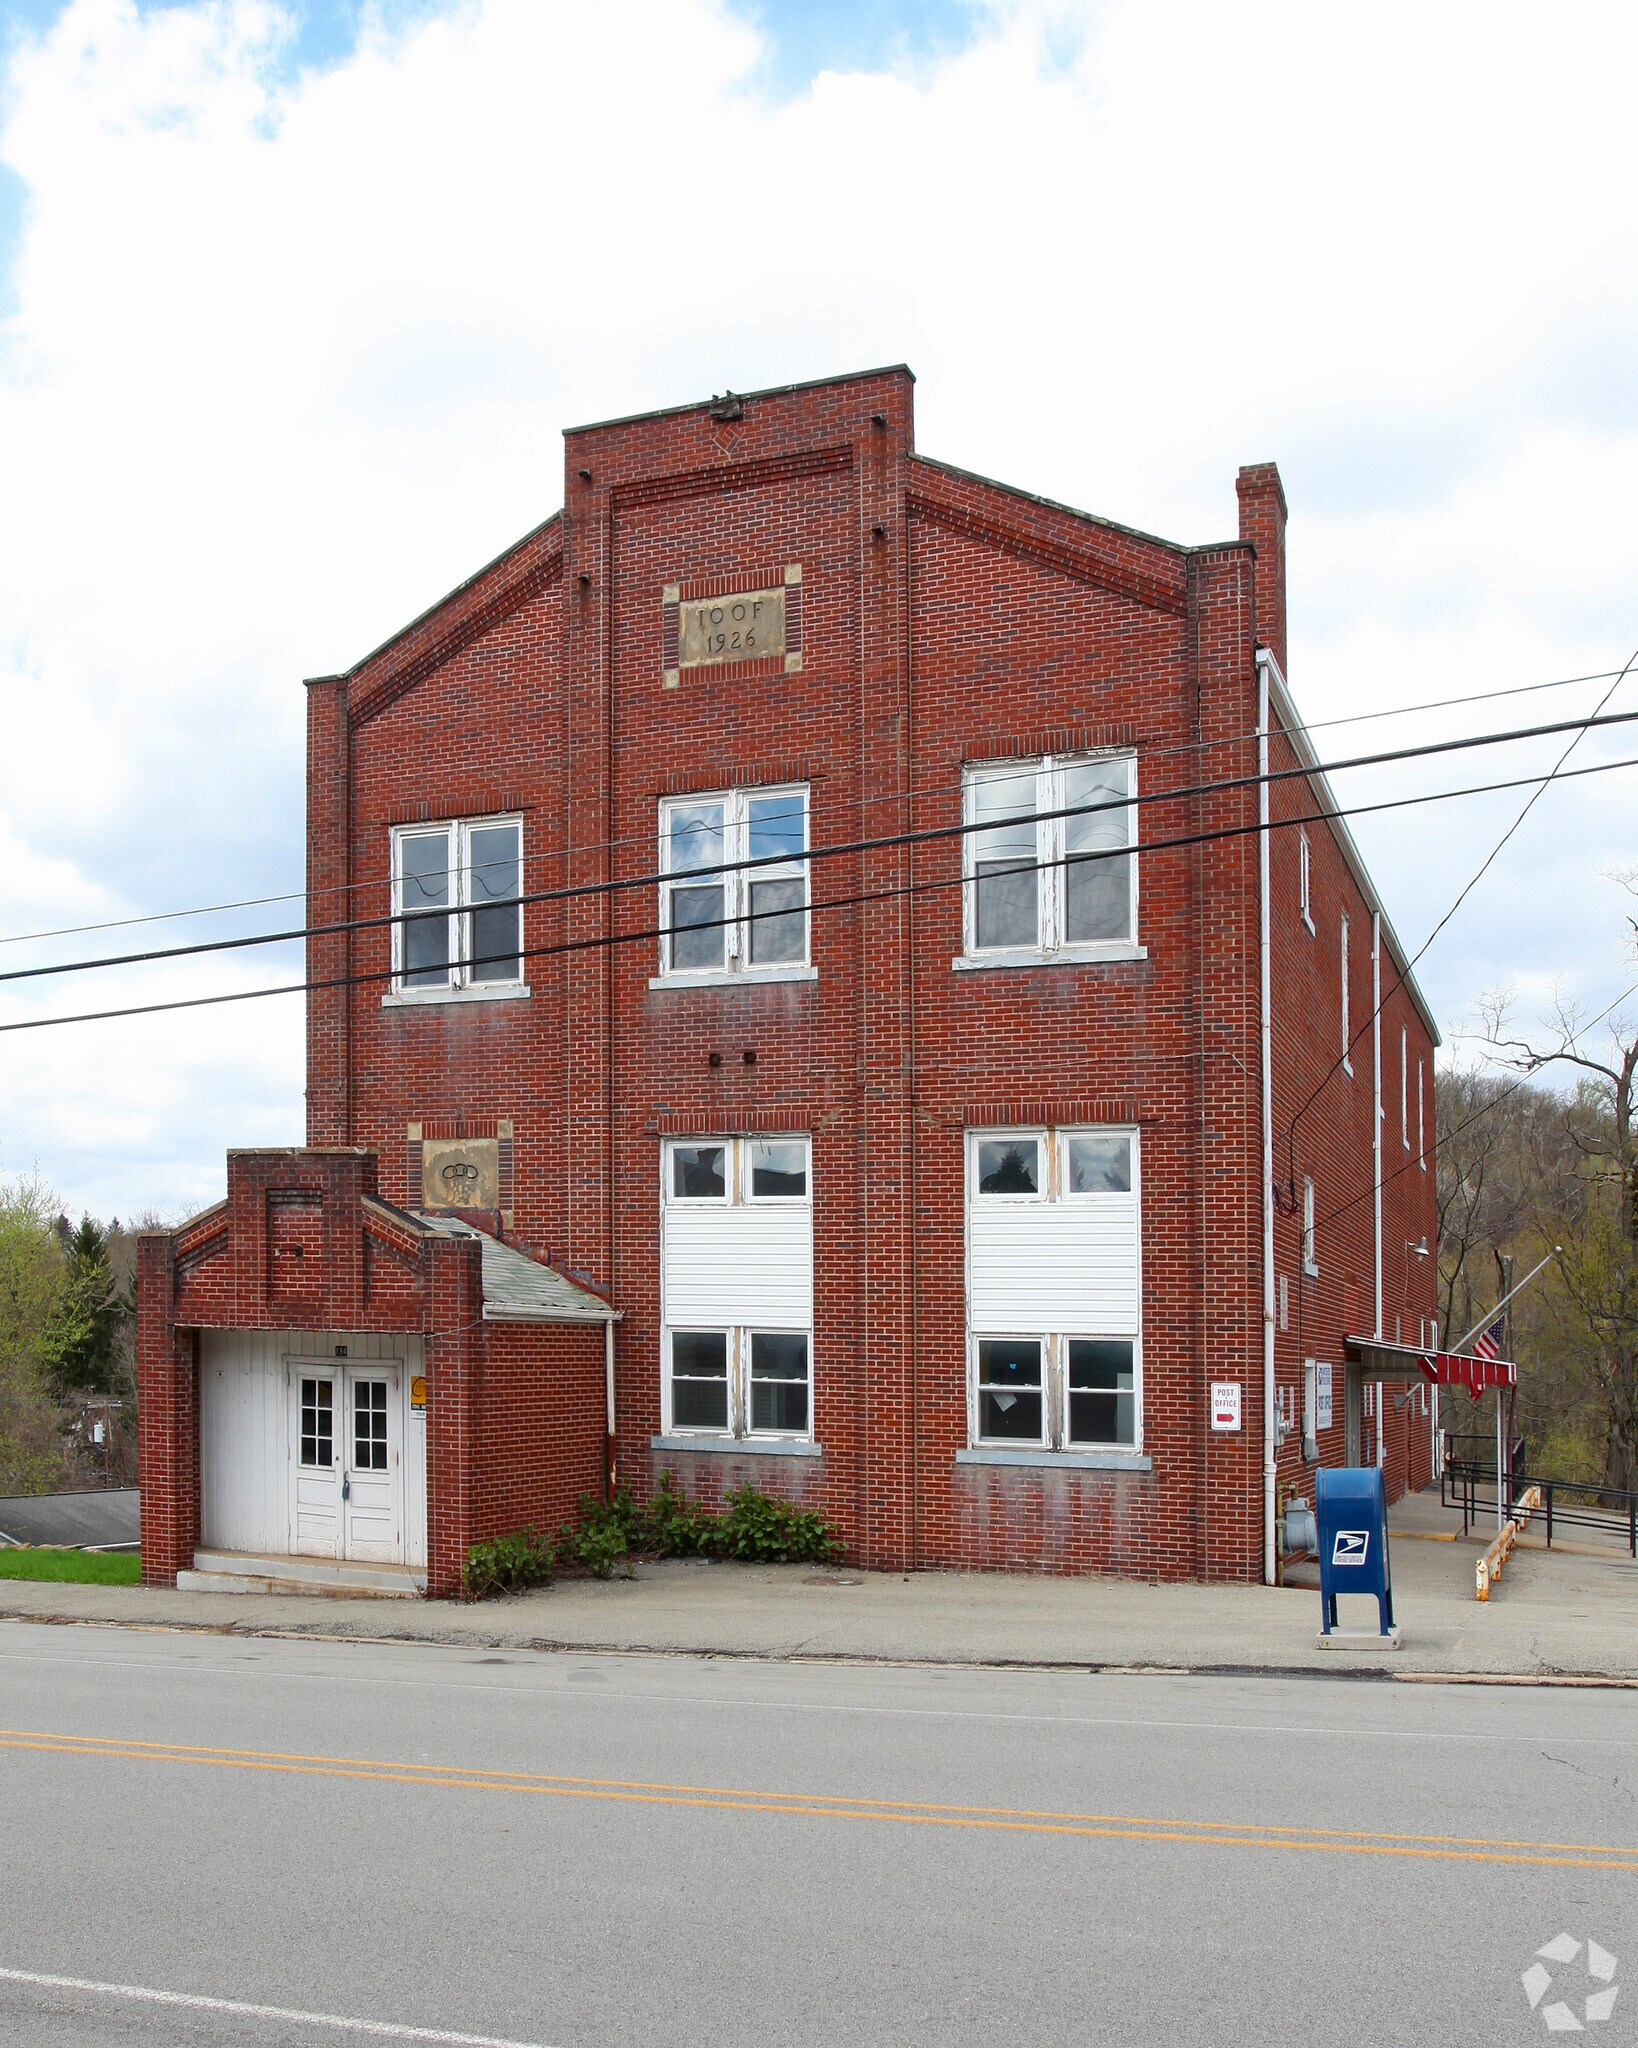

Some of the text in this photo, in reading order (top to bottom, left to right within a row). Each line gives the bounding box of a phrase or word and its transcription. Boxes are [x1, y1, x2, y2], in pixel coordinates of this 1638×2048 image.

[706, 627, 756, 653] 1926
[1217, 1388, 1235, 1396] POST
[1215, 1399, 1237, 1407] OFFICE
